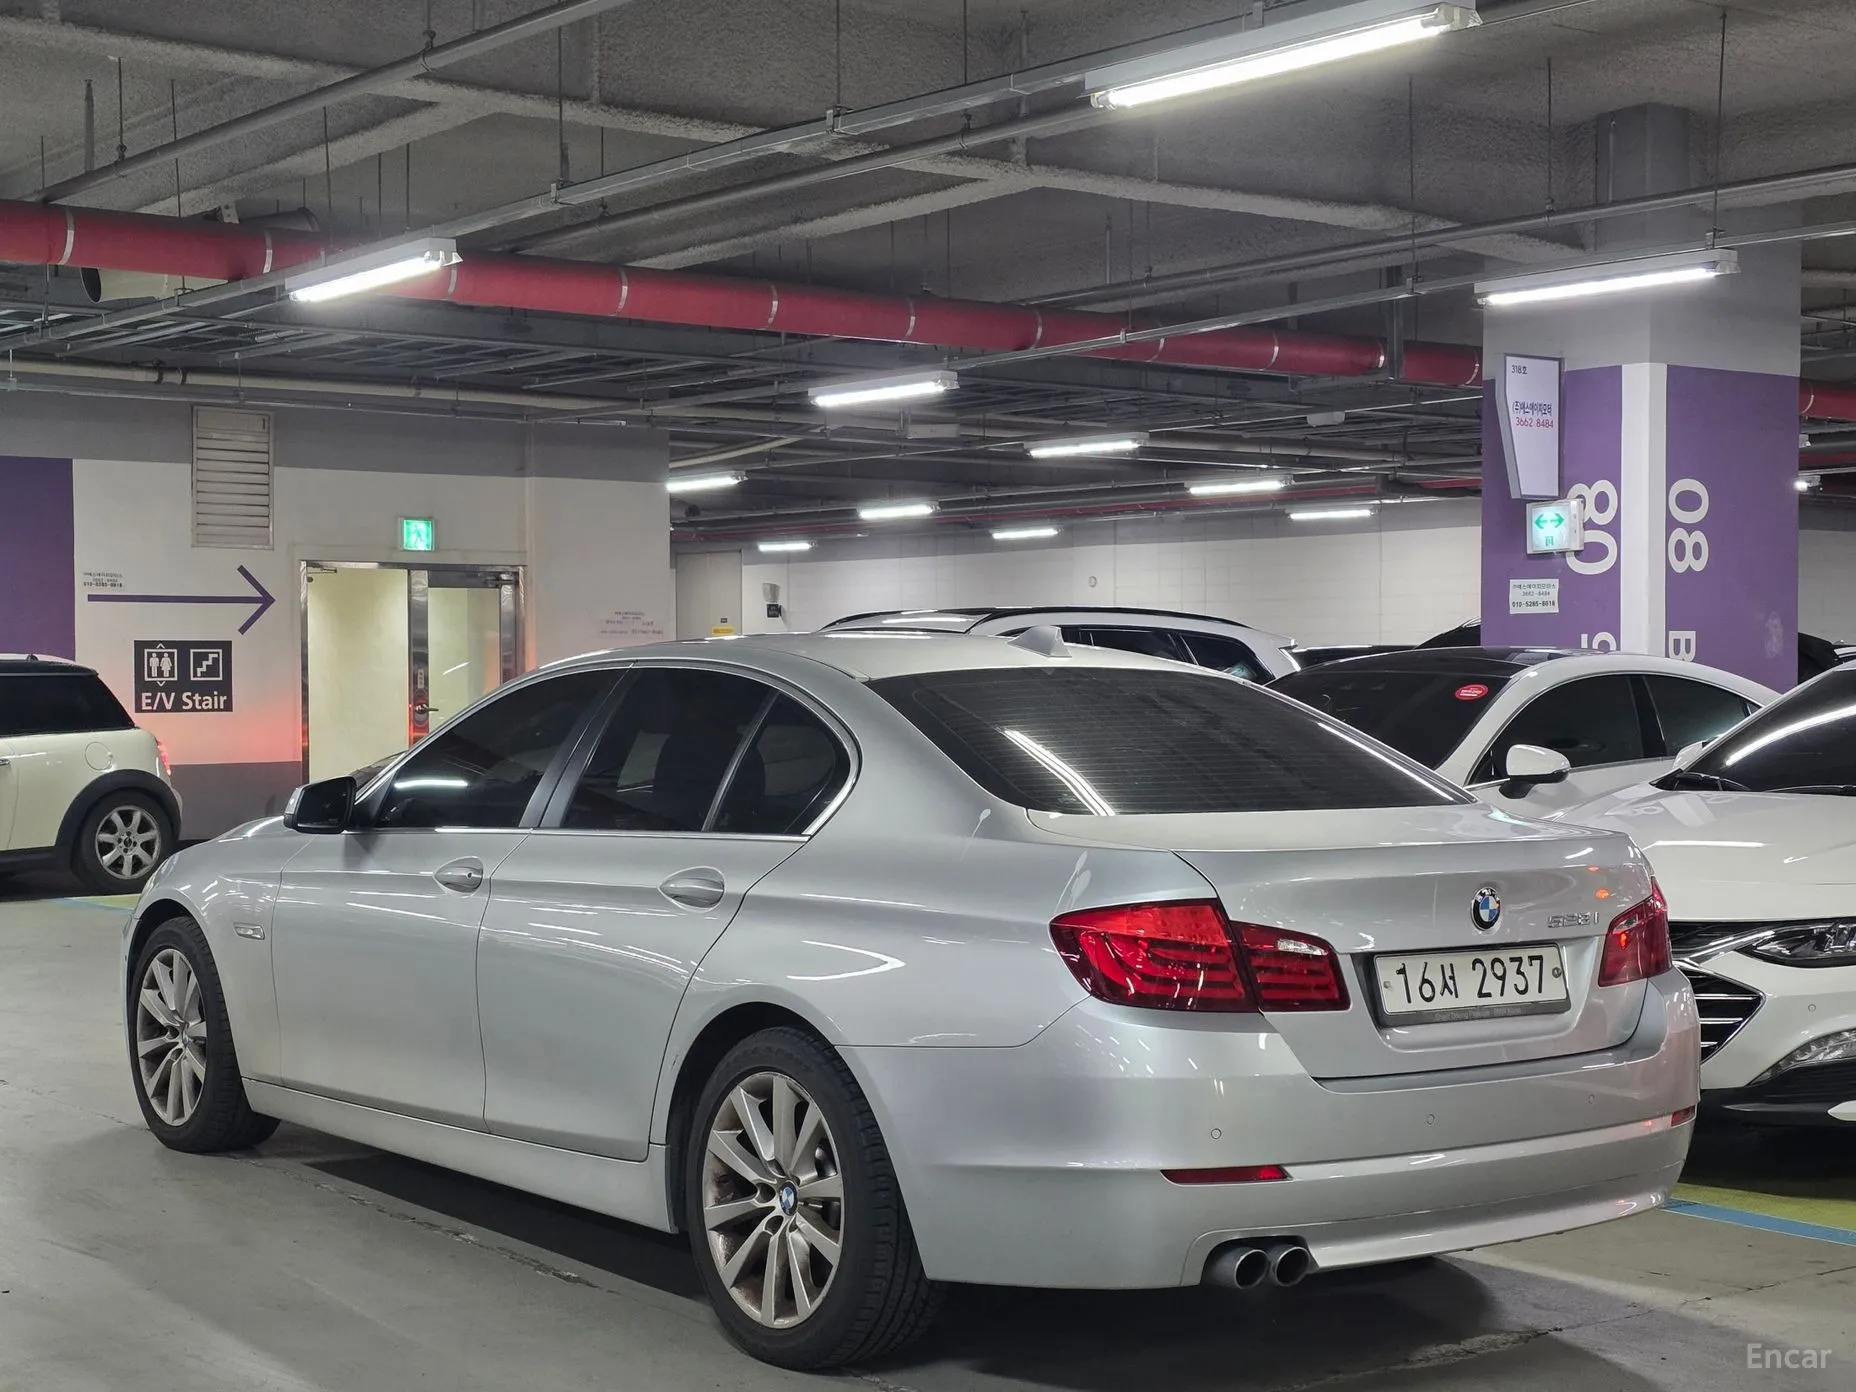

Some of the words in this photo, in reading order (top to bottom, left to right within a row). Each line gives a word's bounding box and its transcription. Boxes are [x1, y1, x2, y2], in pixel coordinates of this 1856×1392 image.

[1515, 416, 1533, 427] 3662
[1536, 418, 1554, 429] 8484
[1669, 478, 1709, 574] 08
[141, 692, 175, 710] E/V
[181, 691, 227, 710] Stair
[1396, 961, 1459, 1003] 16서
[1471, 955, 1543, 998] 2937
